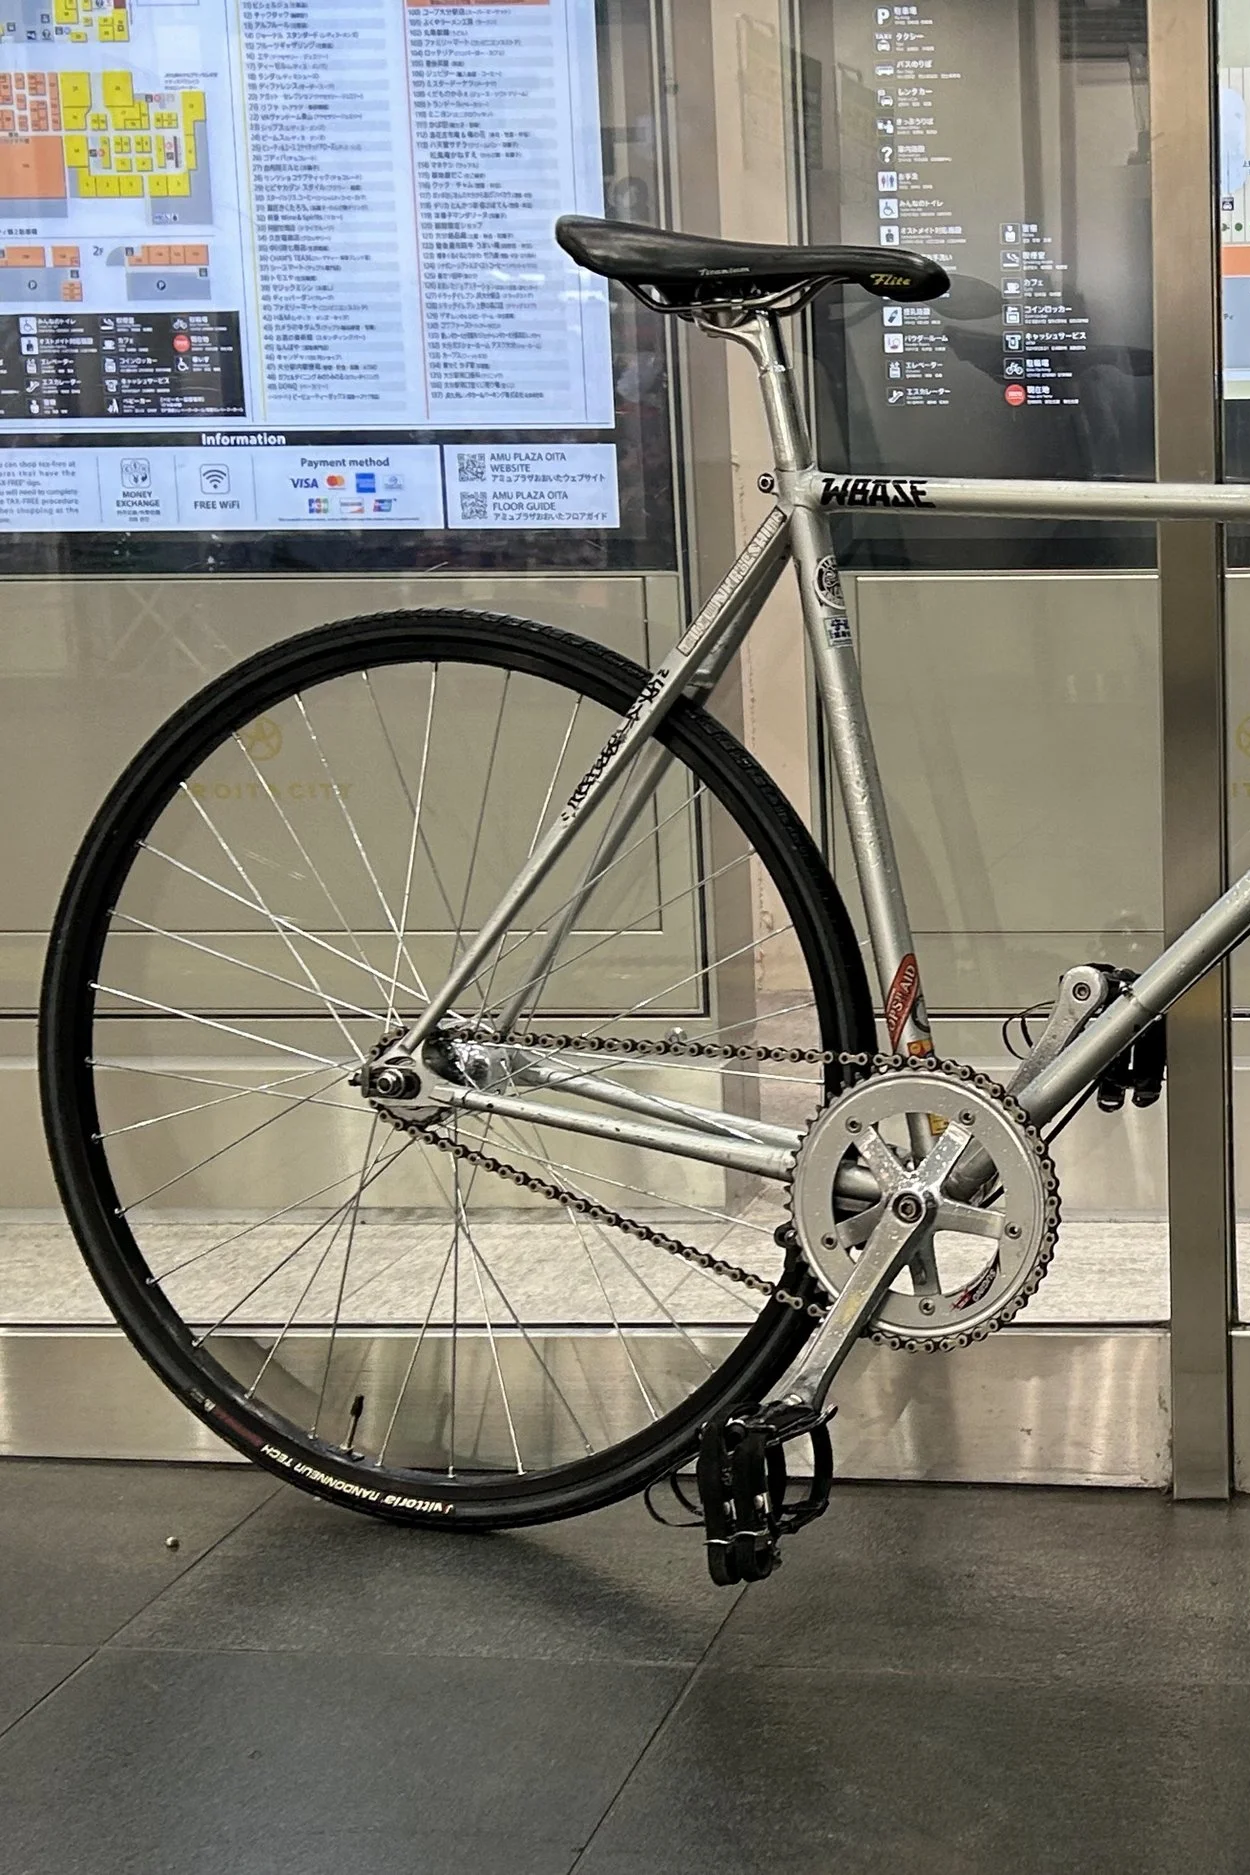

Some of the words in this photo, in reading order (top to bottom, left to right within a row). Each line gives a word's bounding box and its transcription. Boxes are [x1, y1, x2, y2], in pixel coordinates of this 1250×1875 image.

[898, 88, 933, 96] レンタカー
[870, 273, 911, 286] Flite
[1025, 332, 1086, 340] キャッシュサービス
[202, 433, 286, 446] Information
[490, 453, 510, 461] AMU
[514, 453, 543, 461] PLAZA
[545, 452, 566, 461] OITA
[300, 458, 346, 468] Payment
[349, 458, 389, 467] method
[490, 464, 530, 472] WEBSITE
[492, 474, 605, 482] アミュプラザおおいたウェブサイト
[290, 478, 319, 488] VISA
[492, 491, 514, 499] AMU
[516, 491, 545, 499] PLAZA
[547, 491, 568, 499] OITA
[820, 478, 936, 508] WBASE
[194, 501, 217, 509] FREE
[219, 500, 240, 509] WiFi
[527, 502, 556, 510] GUIDE
[494, 513, 607, 521] アミュプラザおおいたフロアガイド
[900, 964, 916, 993] AID
[260, 1444, 294, 1468] TECH
[384, 1494, 444, 1514] vittoria
